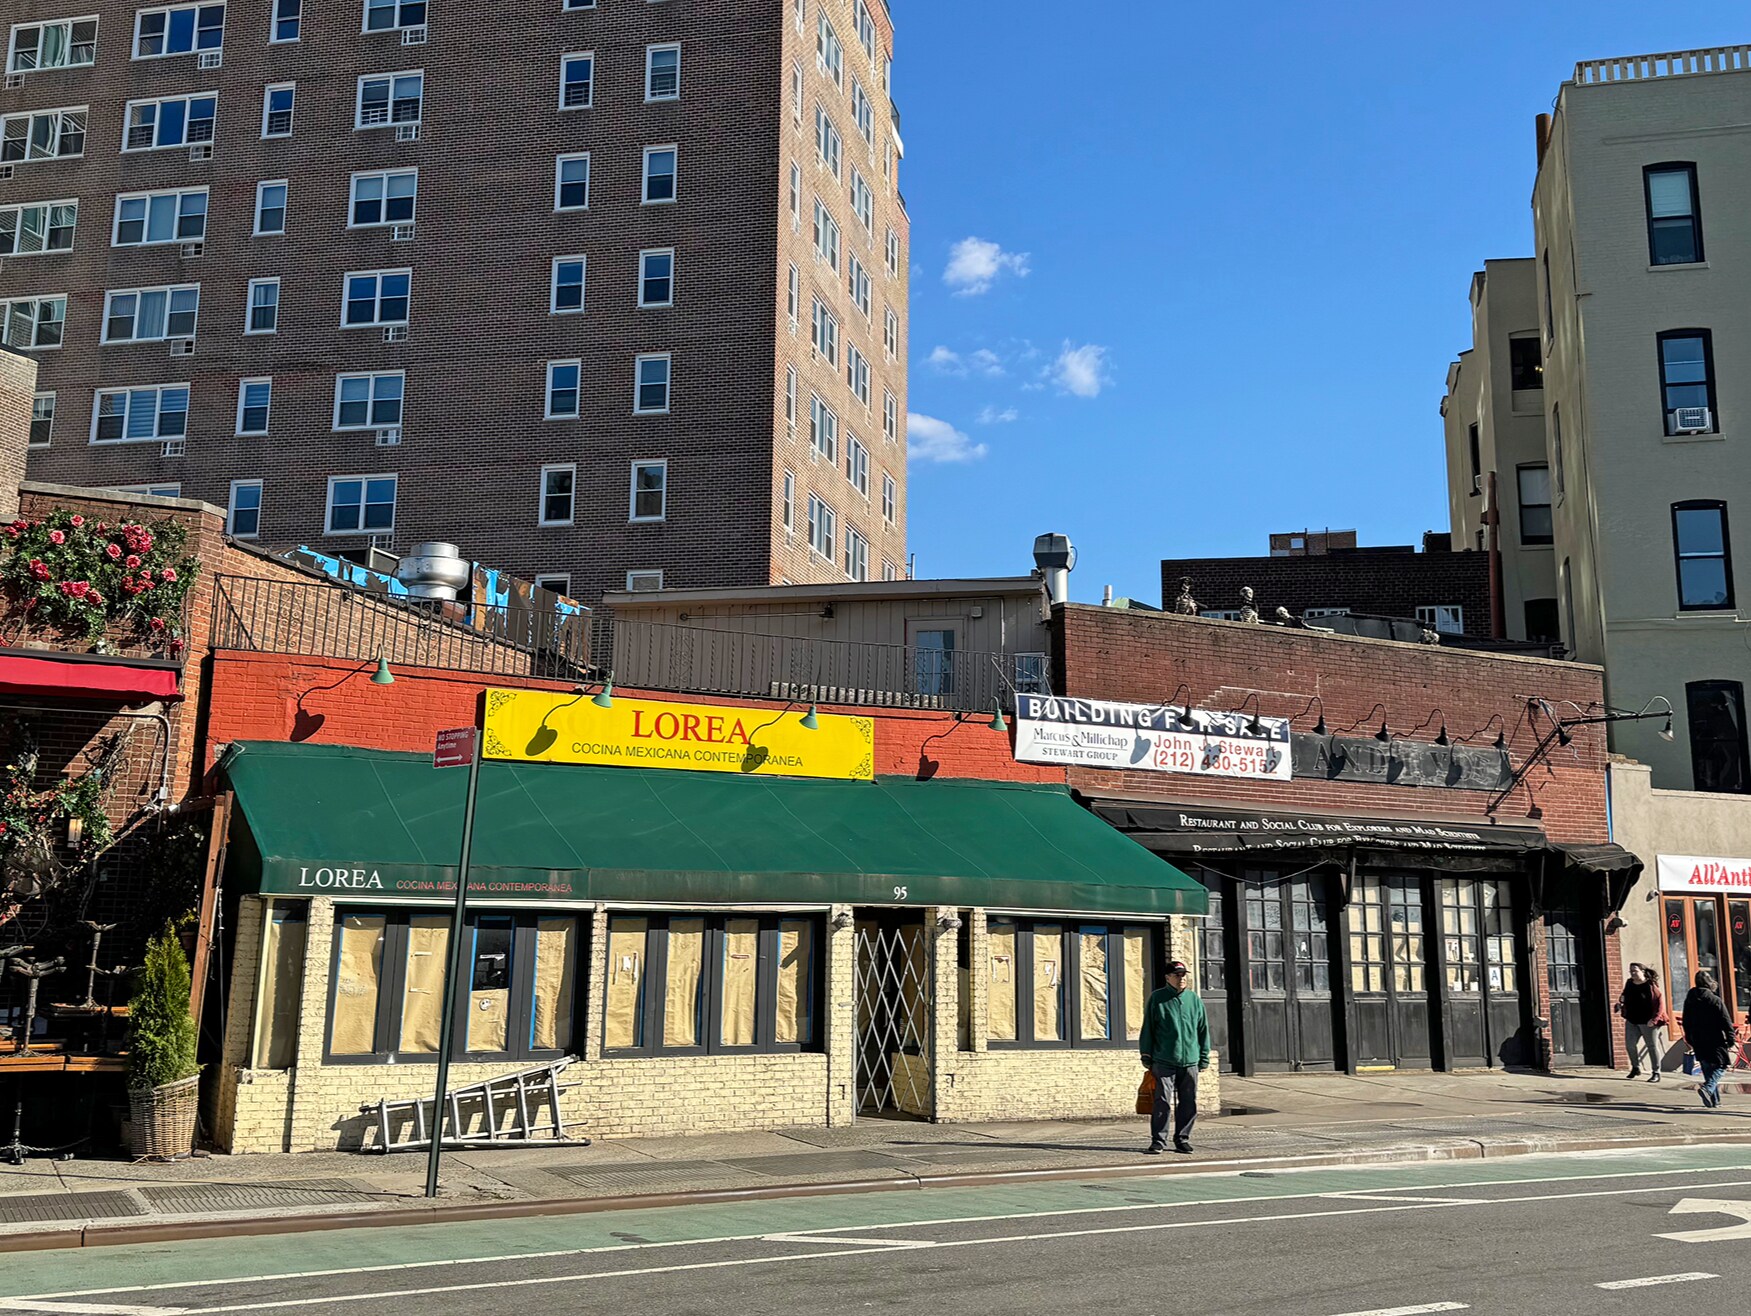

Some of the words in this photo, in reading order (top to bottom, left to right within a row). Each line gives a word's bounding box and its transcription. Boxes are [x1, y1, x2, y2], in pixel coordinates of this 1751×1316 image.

[1028, 698, 1152, 727] BUILDING
[446, 731, 469, 741] STOPPING
[632, 710, 751, 745] LOREA
[1033, 727, 1071, 743] Marcus
[1071, 734, 1082, 748] &
[1081, 731, 1129, 749] Millichap
[437, 741, 457, 750] Anytime
[572, 742, 622, 756] COCINA
[625, 745, 691, 760] MEXICANA
[694, 749, 804, 767] CONTEMPORANEA
[1042, 747, 1084, 759] STEWART
[1086, 750, 1119, 761] GROUP
[1154, 734, 1192, 751] John
[1219, 740, 1277, 759] Stewart
[1153, 749, 1195, 771] (212)
[1201, 754, 1278, 775] 430-5152
[299, 867, 384, 889] LOREA
[396, 879, 435, 890] COCINA
[436, 881, 487, 891] MEXANA
[488, 882, 573, 893] CONTEMPORANEA
[893, 886, 908, 900] 95
[1491, 969, 1499, 981] A
